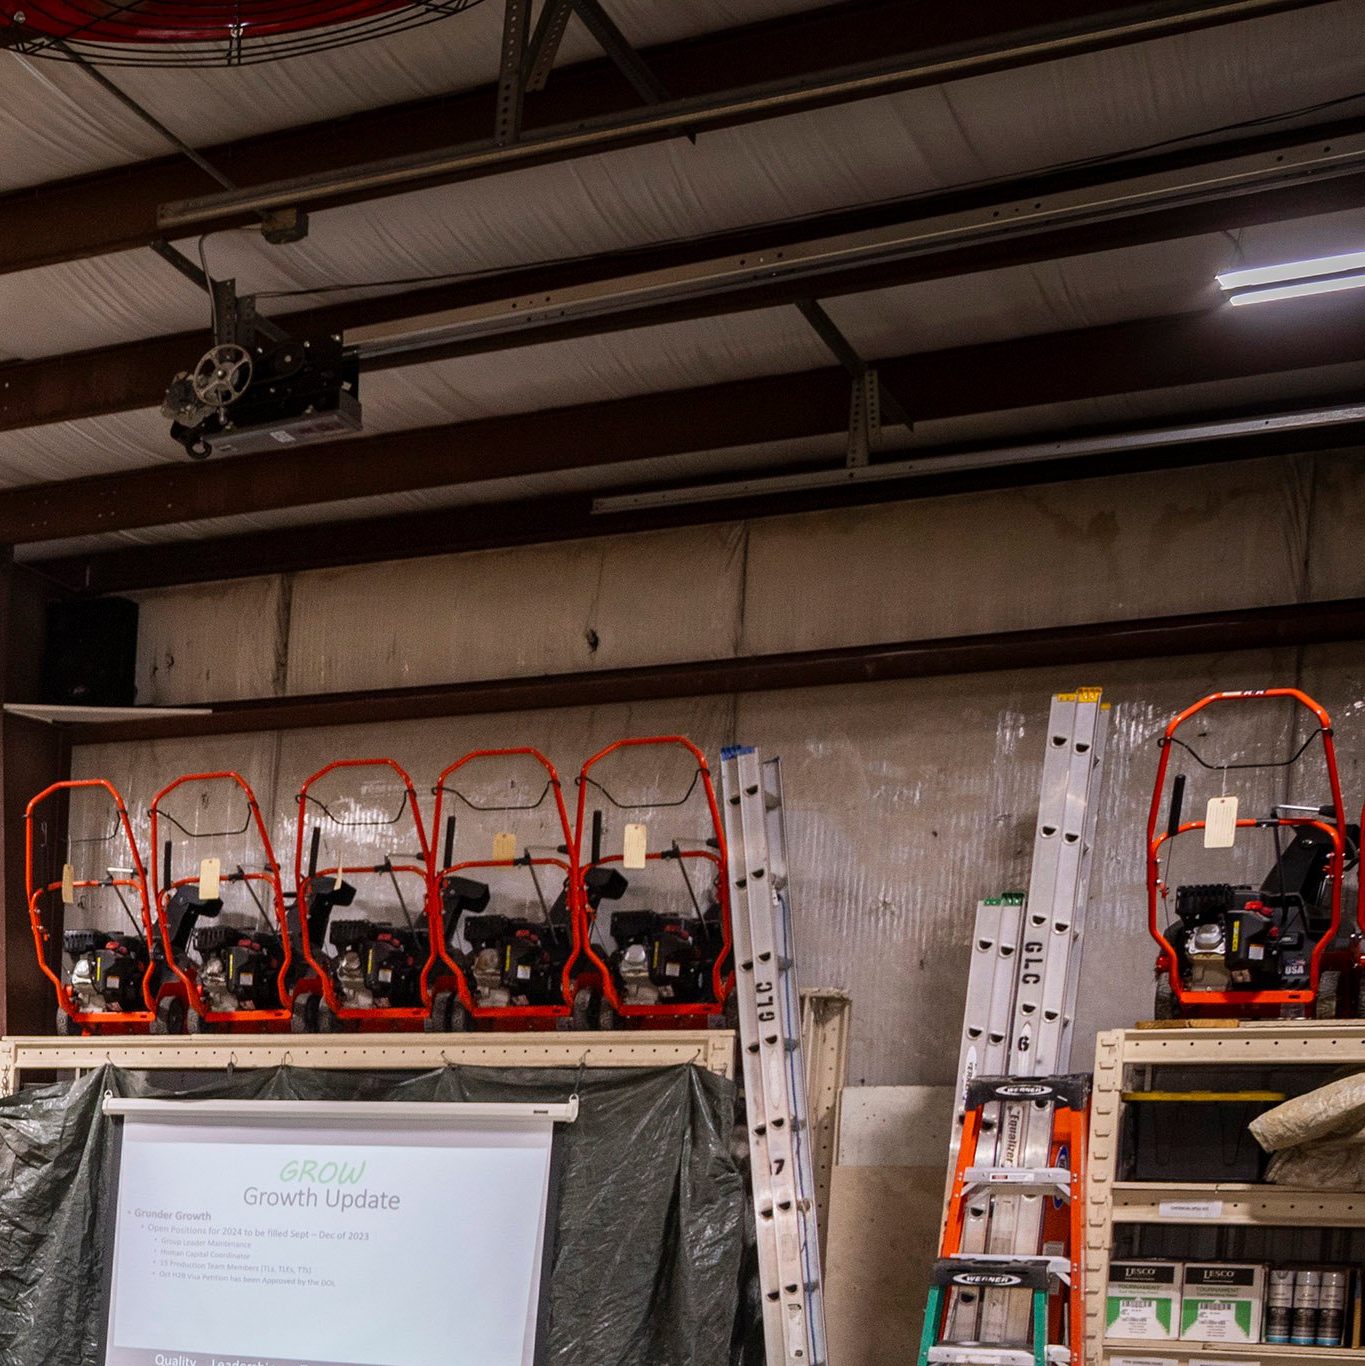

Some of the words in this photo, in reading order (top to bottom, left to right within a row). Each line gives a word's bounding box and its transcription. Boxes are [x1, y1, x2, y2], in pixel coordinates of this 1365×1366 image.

[1022, 941, 1043, 985] GLC
[1285, 965, 1304, 975] USA
[756, 981, 775, 1022] GLC
[1007, 1114, 1019, 1164] Equalizer
[279, 1159, 367, 1185] GROW
[243, 1186, 318, 1207] Growth
[325, 1188, 401, 1212] Update
[134, 1208, 173, 1220] Grunder
[175, 1210, 212, 1221] Growth
[147, 1223, 169, 1233] Open
[170, 1225, 207, 1235] Positions
[208, 1226, 220, 1236] for
[222, 1227, 242, 1236] 2024
[244, 1228, 253, 1236] to
[255, 1227, 265, 1237] be
[267, 1228, 288, 1238] filled
[289, 1230, 309, 1240] Sept
[318, 1230, 335, 1239] Dec
[337, 1230, 346, 1240] of
[348, 1231, 370, 1241] 2023
[207, 1239, 252, 1249] Maintenance
[186, 1250, 209, 1259] Capital
[210, 1251, 251, 1260] Coordinator
[169, 1260, 206, 1270] Production
[207, 1262, 225, 1271] Team
[226, 1262, 259, 1272] Members
[1125, 1267, 1157, 1277] LESCO
[965, 1275, 1010, 1284] WERNER
[1203, 1269, 1235, 1279] LESCO
